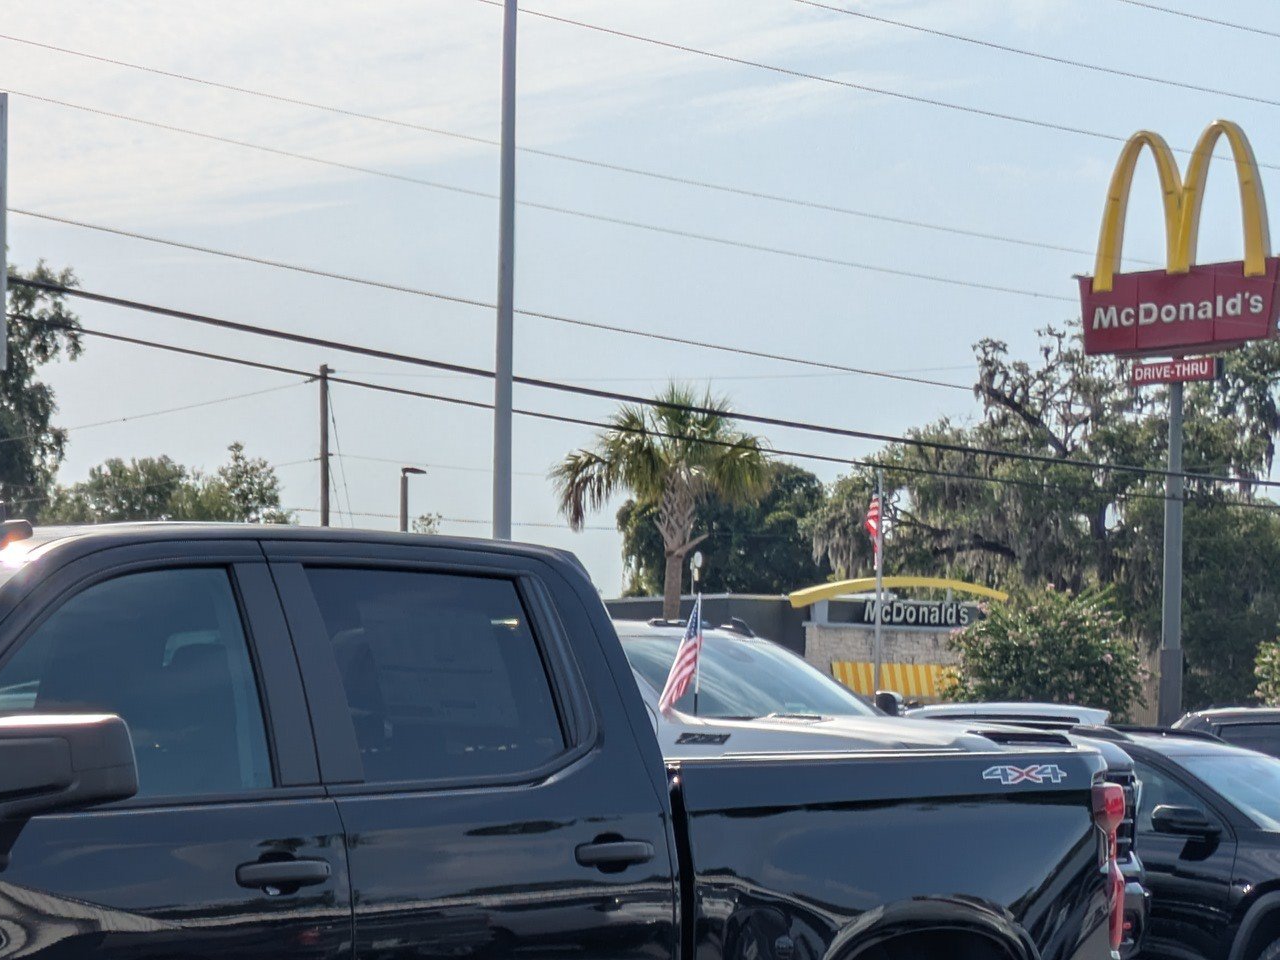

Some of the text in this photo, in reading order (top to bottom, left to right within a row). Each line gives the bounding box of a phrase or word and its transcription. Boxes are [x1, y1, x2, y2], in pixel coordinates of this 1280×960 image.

[1092, 292, 1264, 330] McDonald's
[1134, 361, 1208, 381] DRIVE-THRU
[863, 601, 969, 625] McDonald's
